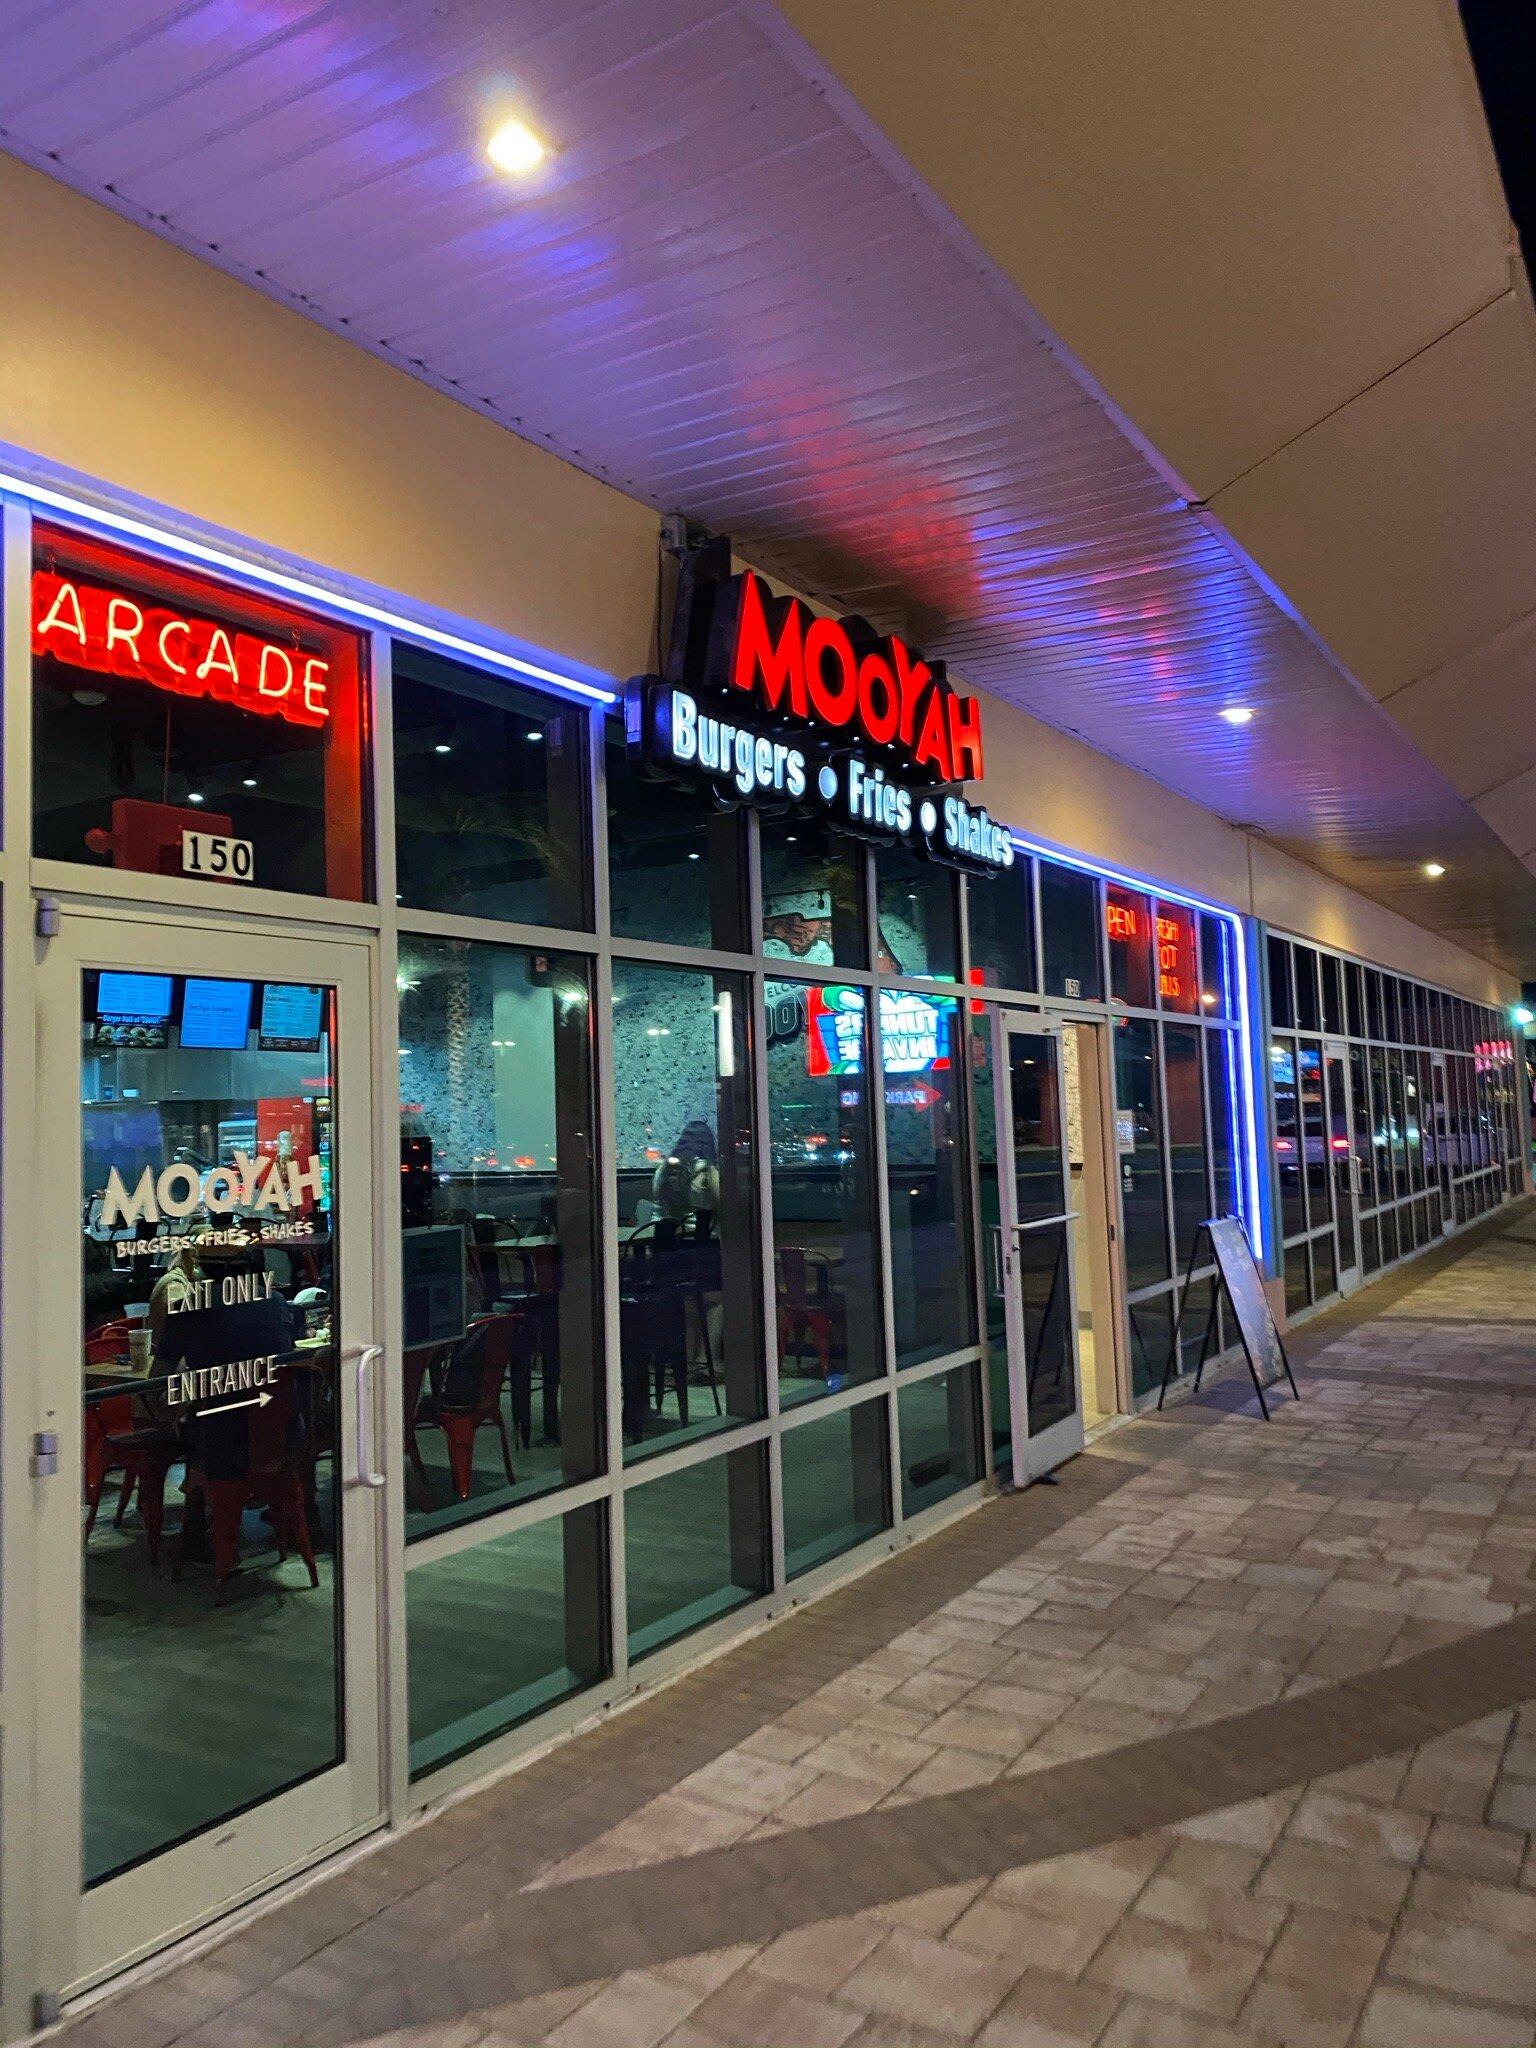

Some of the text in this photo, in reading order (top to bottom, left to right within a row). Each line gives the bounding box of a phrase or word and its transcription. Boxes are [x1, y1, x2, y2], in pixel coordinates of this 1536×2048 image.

[37, 583, 330, 716] ARCADE
[735, 569, 984, 782] MOOYAH
[672, 689, 1015, 867] Burgers Fries Shakes
[189, 837, 252, 877] 150
[1107, 905, 1137, 935] PEN
[100, 1150, 325, 1229] MOOYAH
[116, 1221, 314, 1258] BURGERS FRIES SHAKES
[167, 1270, 275, 1314] EXIT ONLY
[167, 1354, 279, 1405] ENTRANCE
